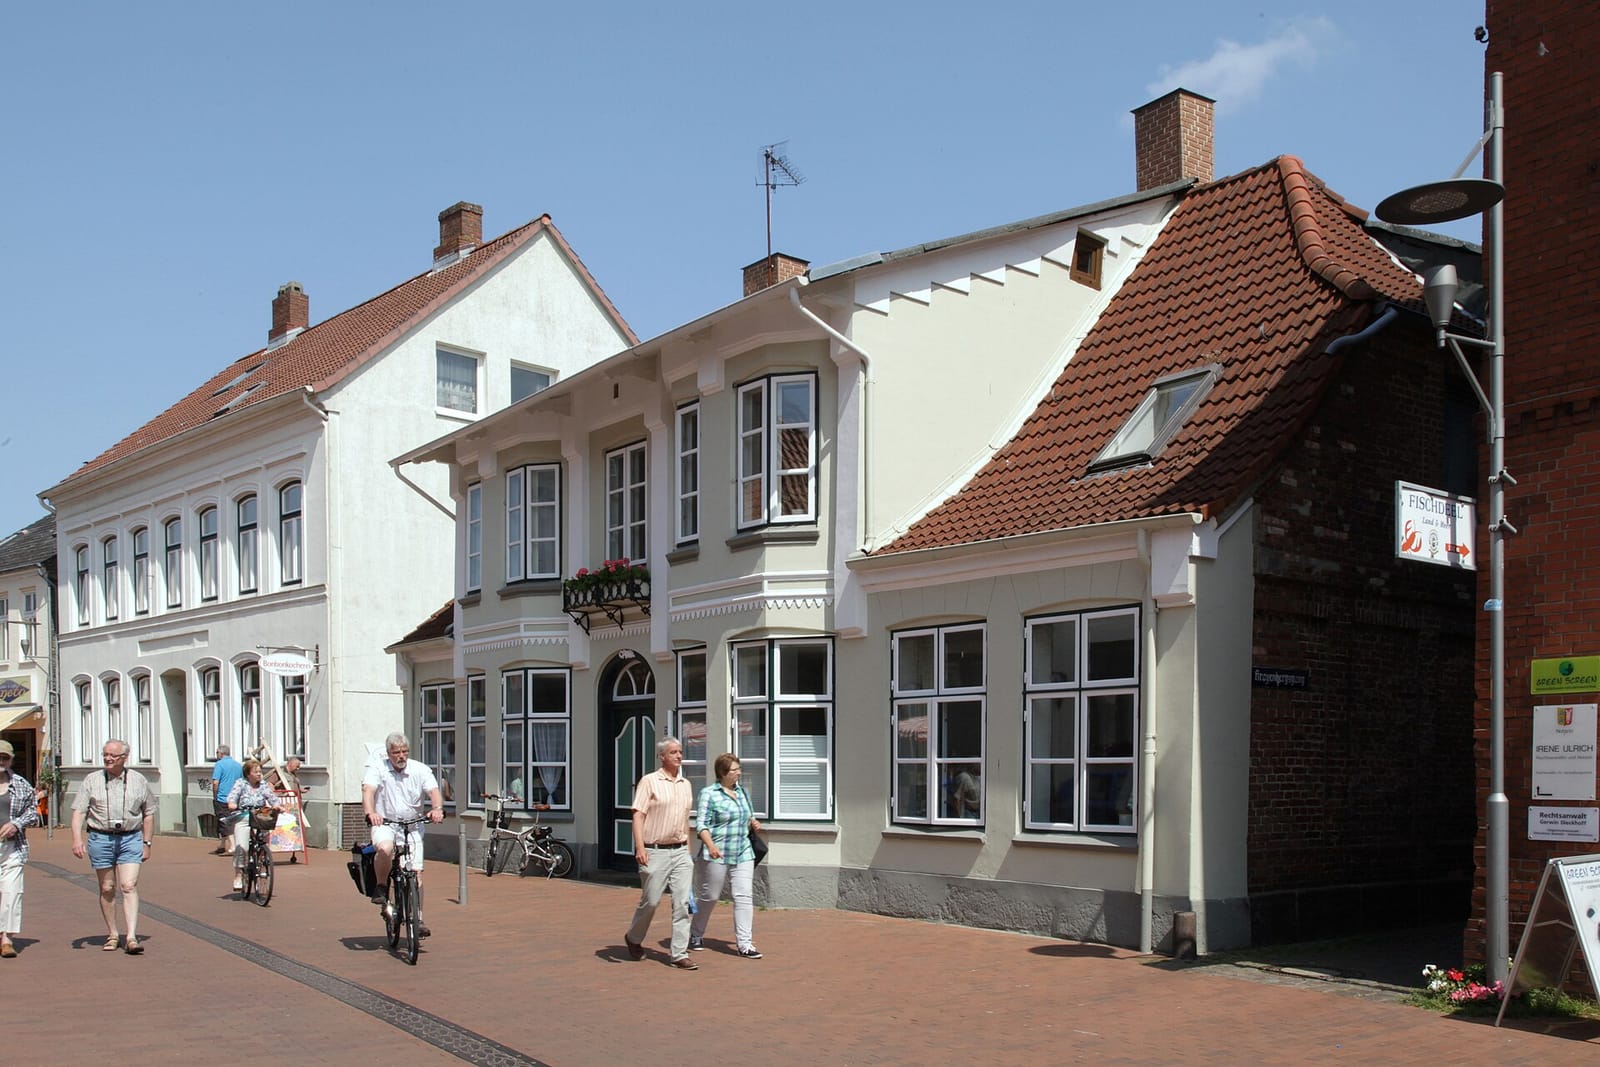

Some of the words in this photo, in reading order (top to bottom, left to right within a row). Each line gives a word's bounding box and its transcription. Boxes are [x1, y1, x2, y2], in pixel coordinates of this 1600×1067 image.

[1409, 494, 1464, 519] FISCHDEEL
[1536, 677, 1563, 687] GREEN
[1565, 674, 1597, 684] SCREEN
[1536, 744, 1560, 753] IRENE
[1563, 744, 1594, 753] ULRICH
[1540, 811, 1587, 820] Rechtsanwalt
